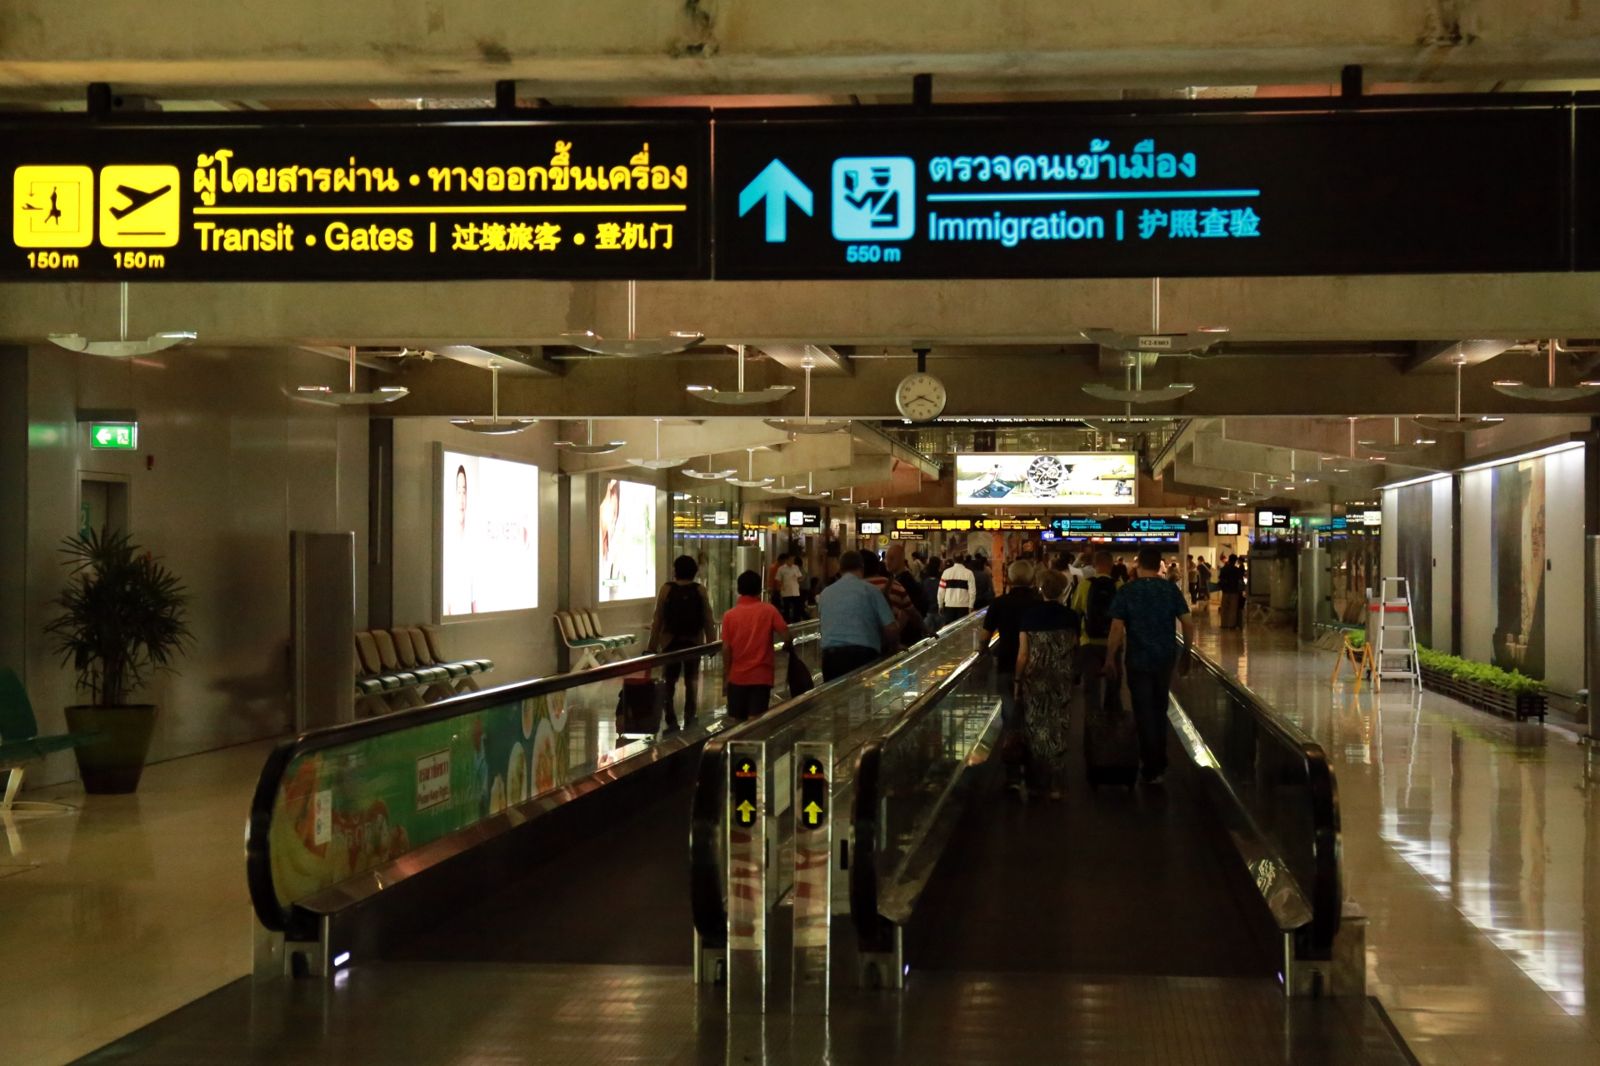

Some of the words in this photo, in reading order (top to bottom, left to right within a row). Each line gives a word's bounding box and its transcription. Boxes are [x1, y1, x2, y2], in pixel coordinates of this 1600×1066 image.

[193, 149, 400, 206] ผู้โดยสารผ่าน
[427, 140, 688, 192] ทางออกขึ้นเครื่อง
[928, 138, 1197, 182] ตรวจคนเข้าเมือง
[193, 222, 294, 251] Transit
[324, 221, 414, 251] Gates
[451, 222, 562, 251] 过境旅客
[594, 222, 674, 251] 登机门
[928, 210, 1105, 247] Immigration
[1138, 207, 1261, 238] 护照查验
